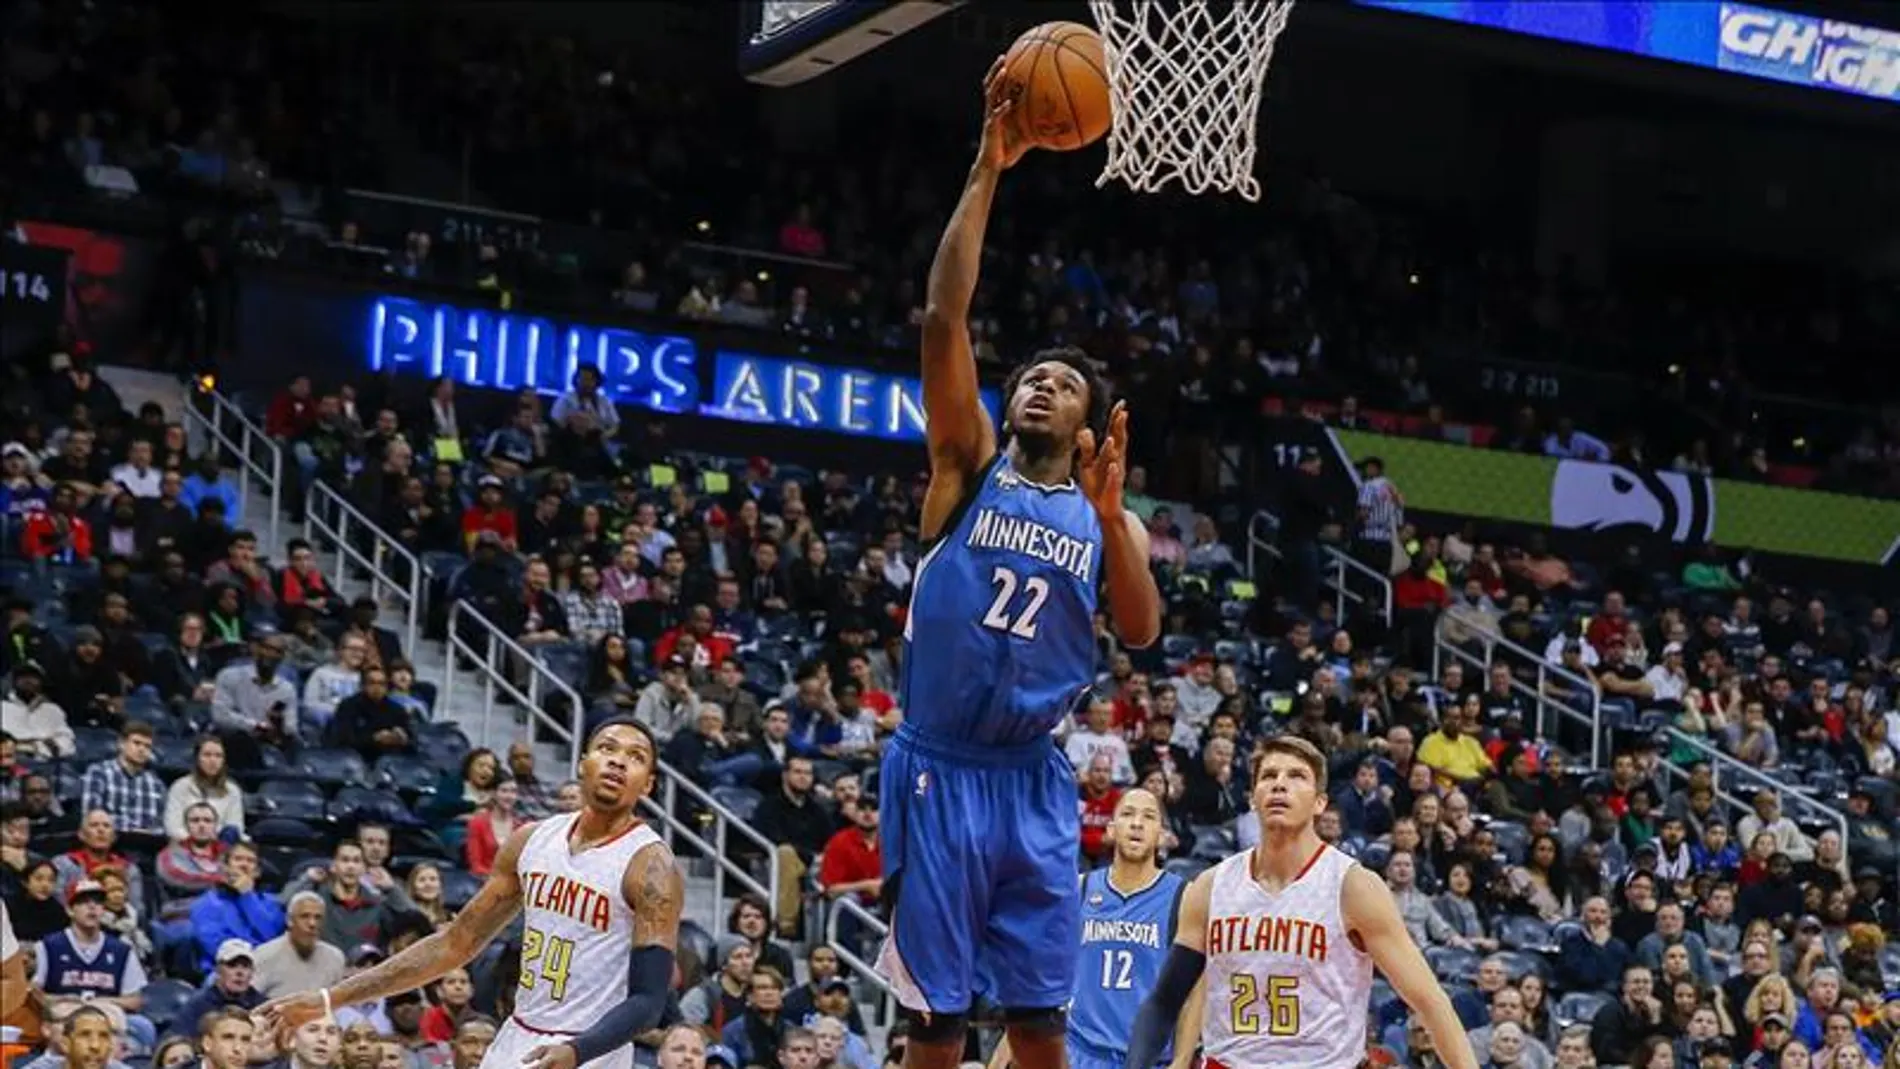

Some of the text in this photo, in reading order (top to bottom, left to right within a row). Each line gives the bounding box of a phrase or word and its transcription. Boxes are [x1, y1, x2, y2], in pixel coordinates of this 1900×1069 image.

[724, 359, 927, 433] AREN
[967, 507, 1096, 583] MINNESOTA
[982, 566, 1051, 639] 22
[522, 871, 610, 933] TLANTA
[1080, 919, 1160, 949] MINNESOTA
[519, 925, 575, 1003] 24
[1101, 949, 1134, 990] 12
[1209, 915, 1328, 963] ATLANTA
[1230, 973, 1300, 1037] 26
